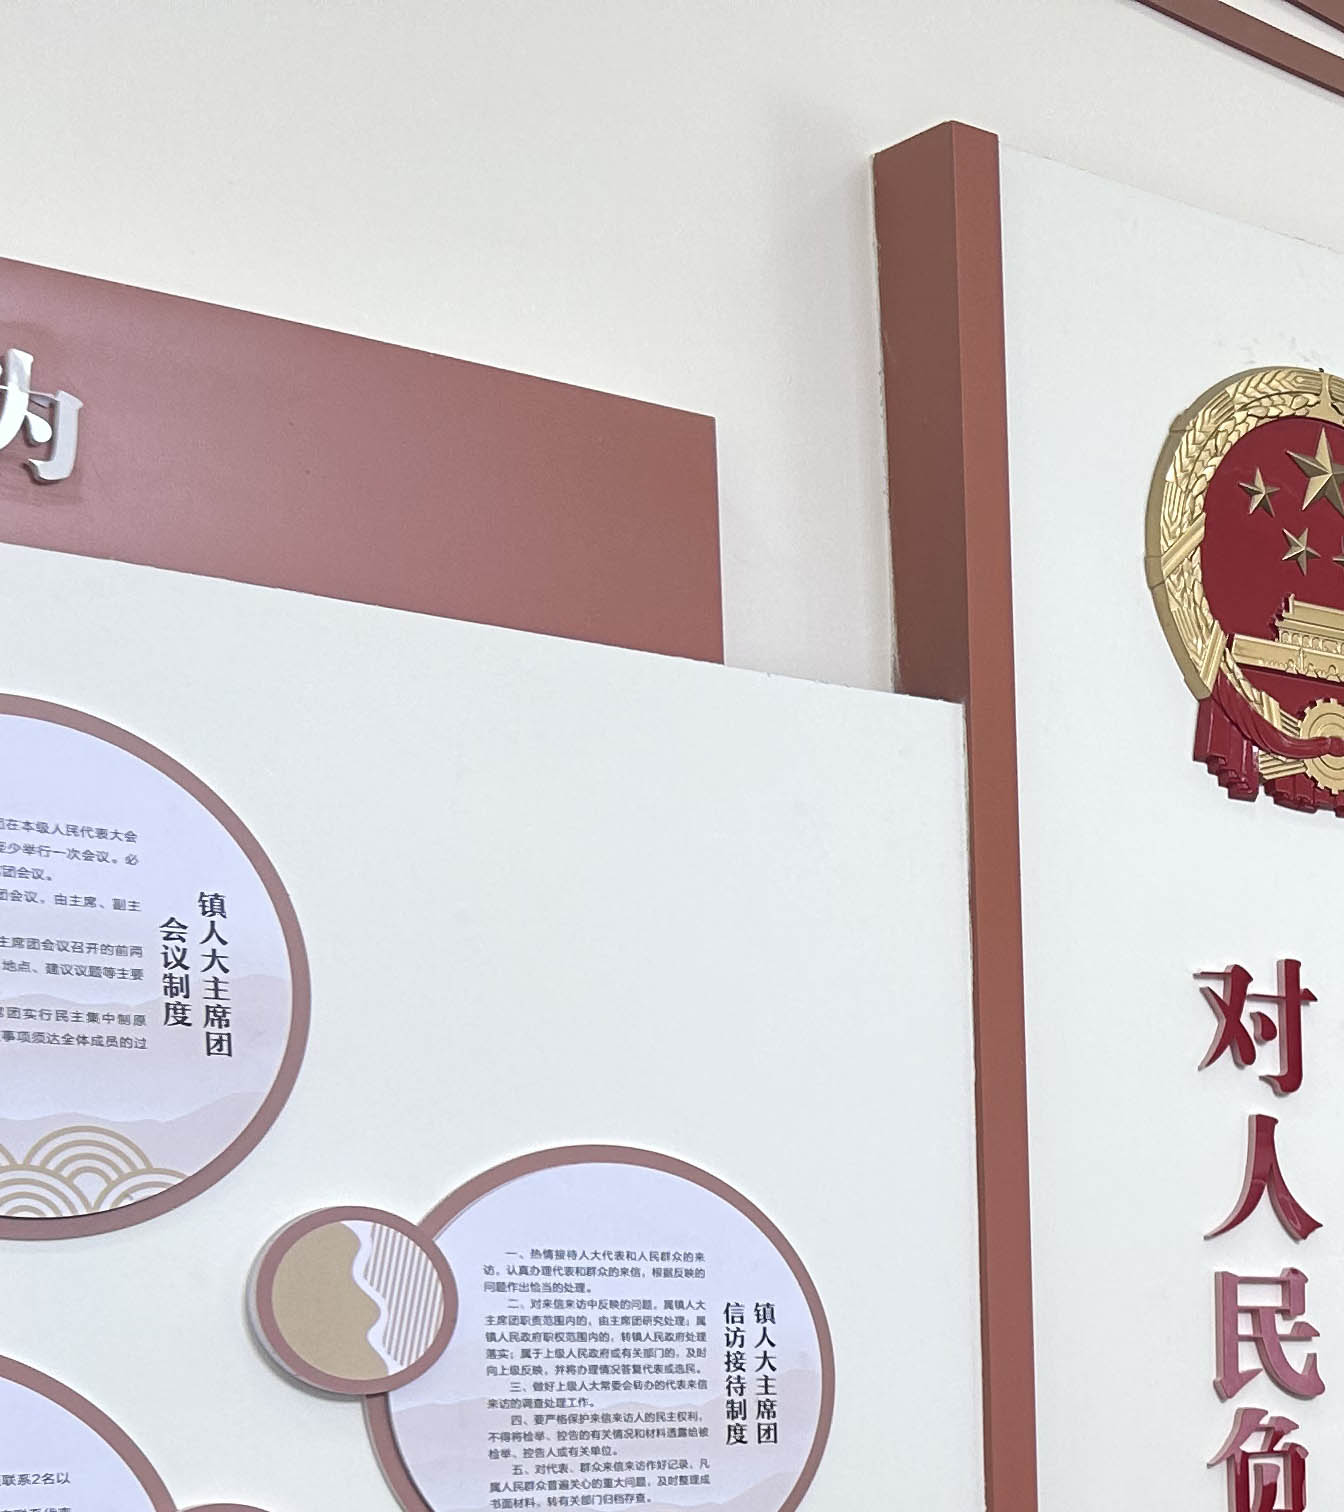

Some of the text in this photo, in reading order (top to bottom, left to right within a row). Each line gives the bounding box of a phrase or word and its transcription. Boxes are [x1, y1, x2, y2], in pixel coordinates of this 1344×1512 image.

[0, 348, 84, 481] 为
[0, 818, 137, 843] 在本级人民代表大会
[160, 917, 192, 1027] 会议制度
[198, 892, 233, 1057] 镇人大主席团
[723, 1302, 748, 1445] 信访接待制度
[754, 1302, 777, 1444] 镇人大主席团
